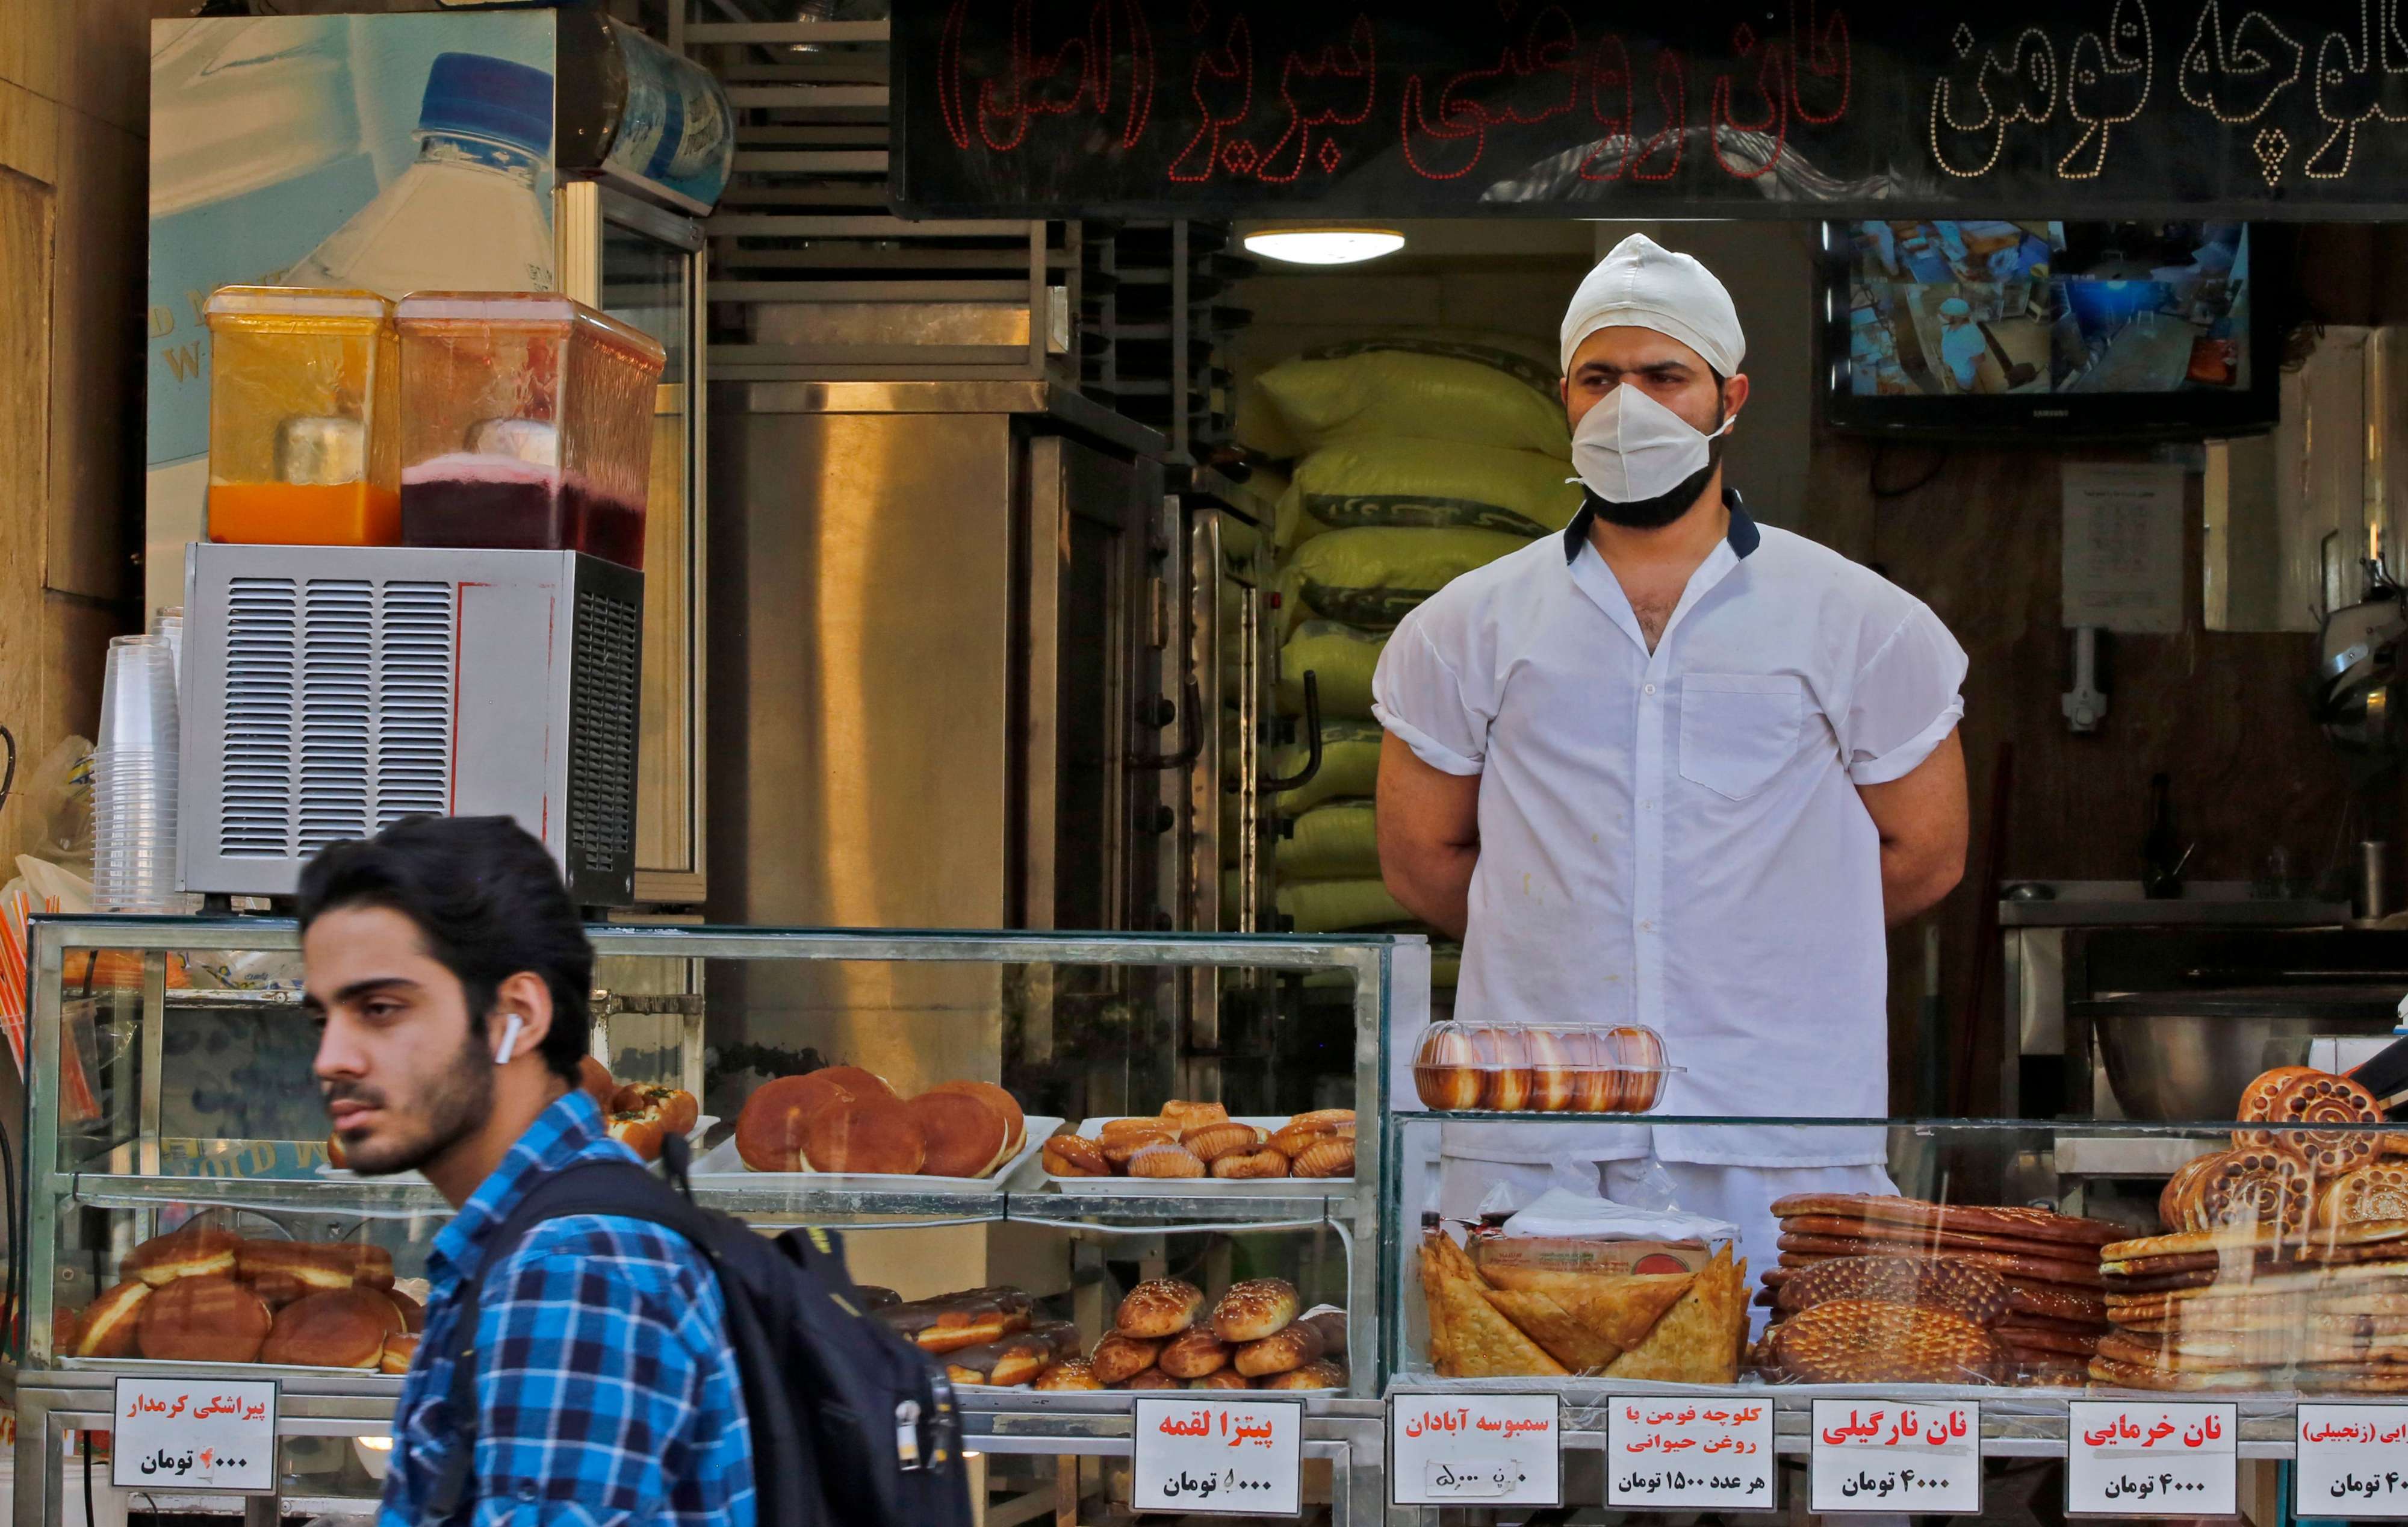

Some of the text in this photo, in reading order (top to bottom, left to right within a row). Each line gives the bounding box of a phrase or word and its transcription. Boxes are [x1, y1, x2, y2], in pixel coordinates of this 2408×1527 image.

[1931, 0, 2153, 177] فومن
[126, 1393, 265, 1421] پیراشکی کرمدار
[1626, 1405, 1763, 1426] کلوچه فومن با
[1220, 1410, 1273, 1449] پیتزا
[1406, 1408, 1549, 1438] سمبوسه آبادان
[1822, 1410, 1968, 1445] نان نارگیلی
[2084, 1413, 2222, 1448] نان خرمایی
[2302, 1421, 2408, 1444] ایی (زنجبیلی)
[1626, 1433, 1757, 1454] روغن حیوانی
[141, 1449, 194, 1475] تومان
[1163, 1471, 1217, 1498] تومان
[1619, 1471, 1765, 1494] هر عدد ۱۵۰۰ تومان
[1842, 1469, 1950, 1497] ۴۰۰۰ تومان
[2105, 1473, 2205, 1499] ۴۰۰۰ تومان
[2330, 1472, 2408, 1498] ۴۰ تومان
